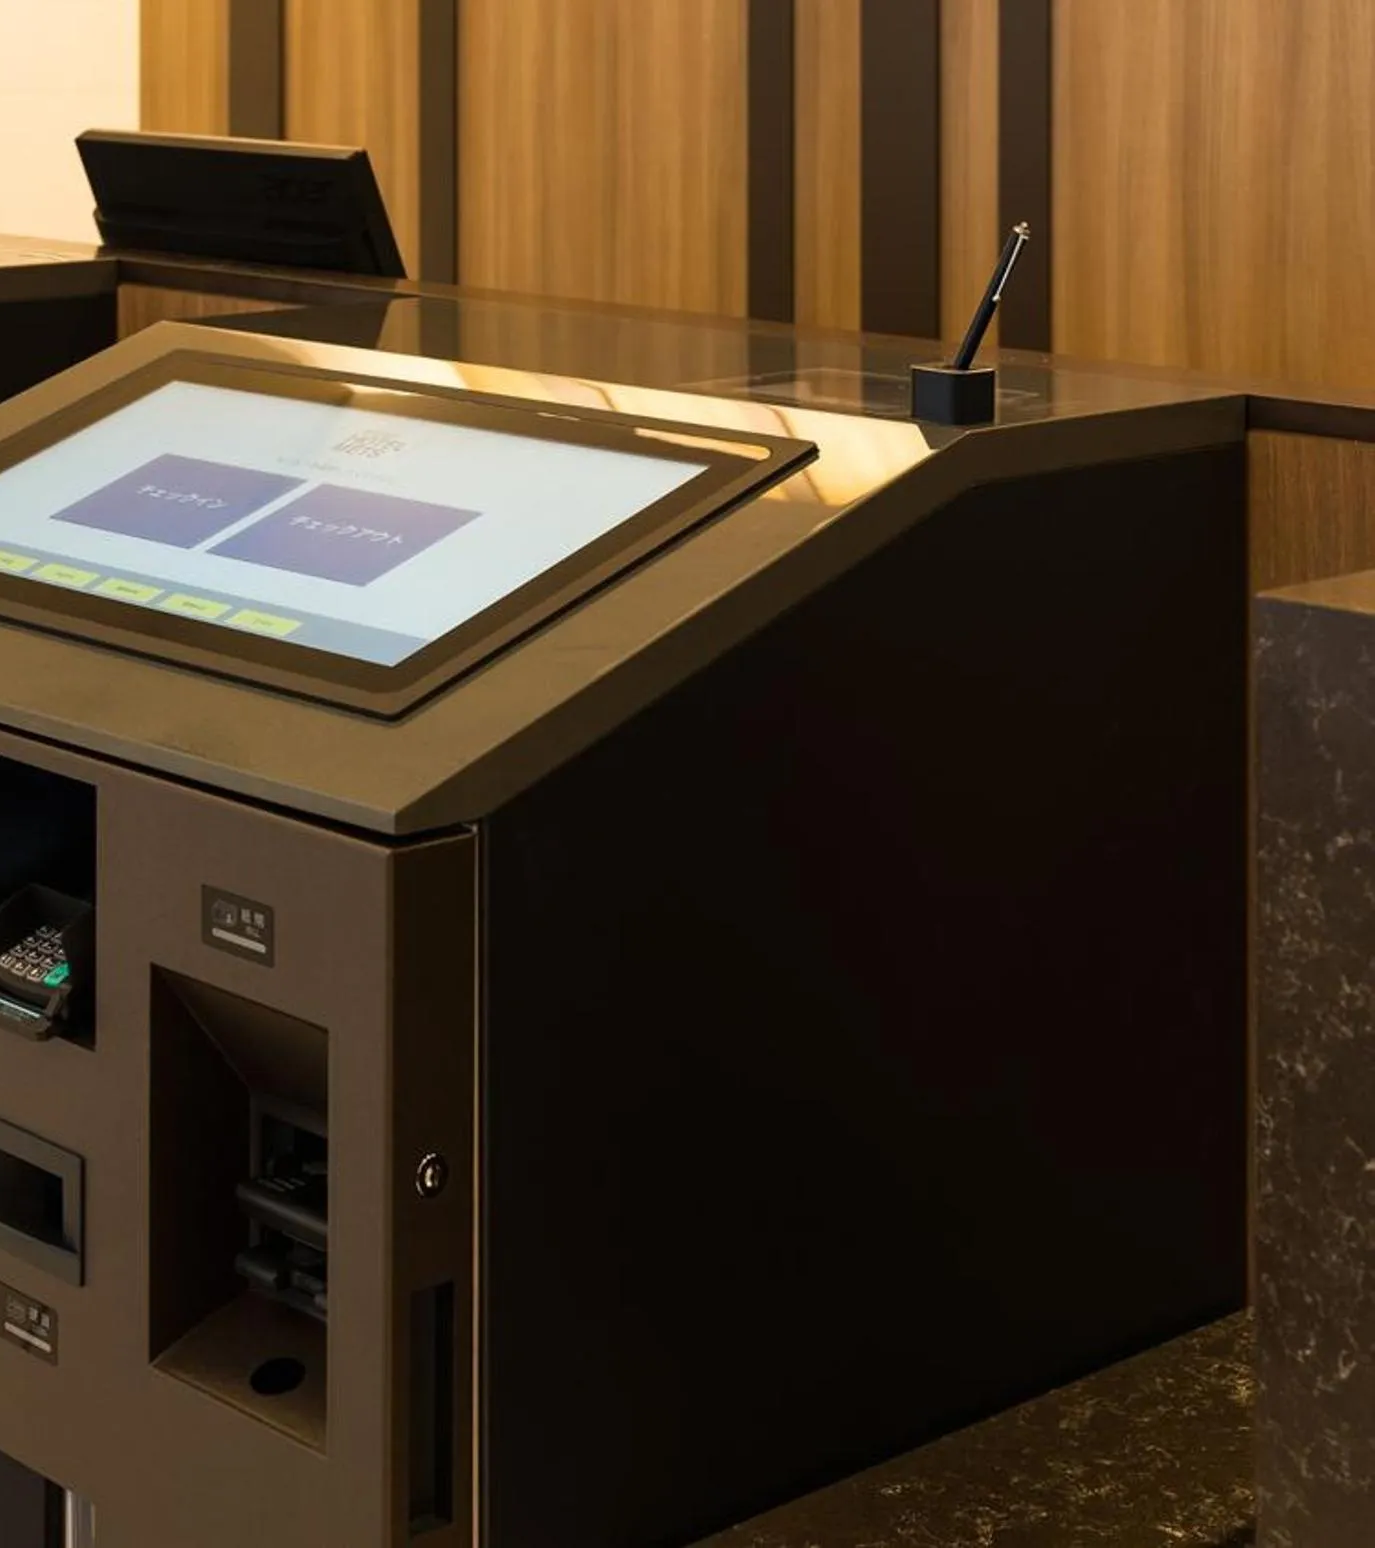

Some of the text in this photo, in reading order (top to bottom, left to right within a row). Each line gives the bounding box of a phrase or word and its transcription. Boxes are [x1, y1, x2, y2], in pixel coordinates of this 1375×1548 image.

[136, 484, 227, 509] チェックイン
[288, 515, 404, 545] チェックアウト
